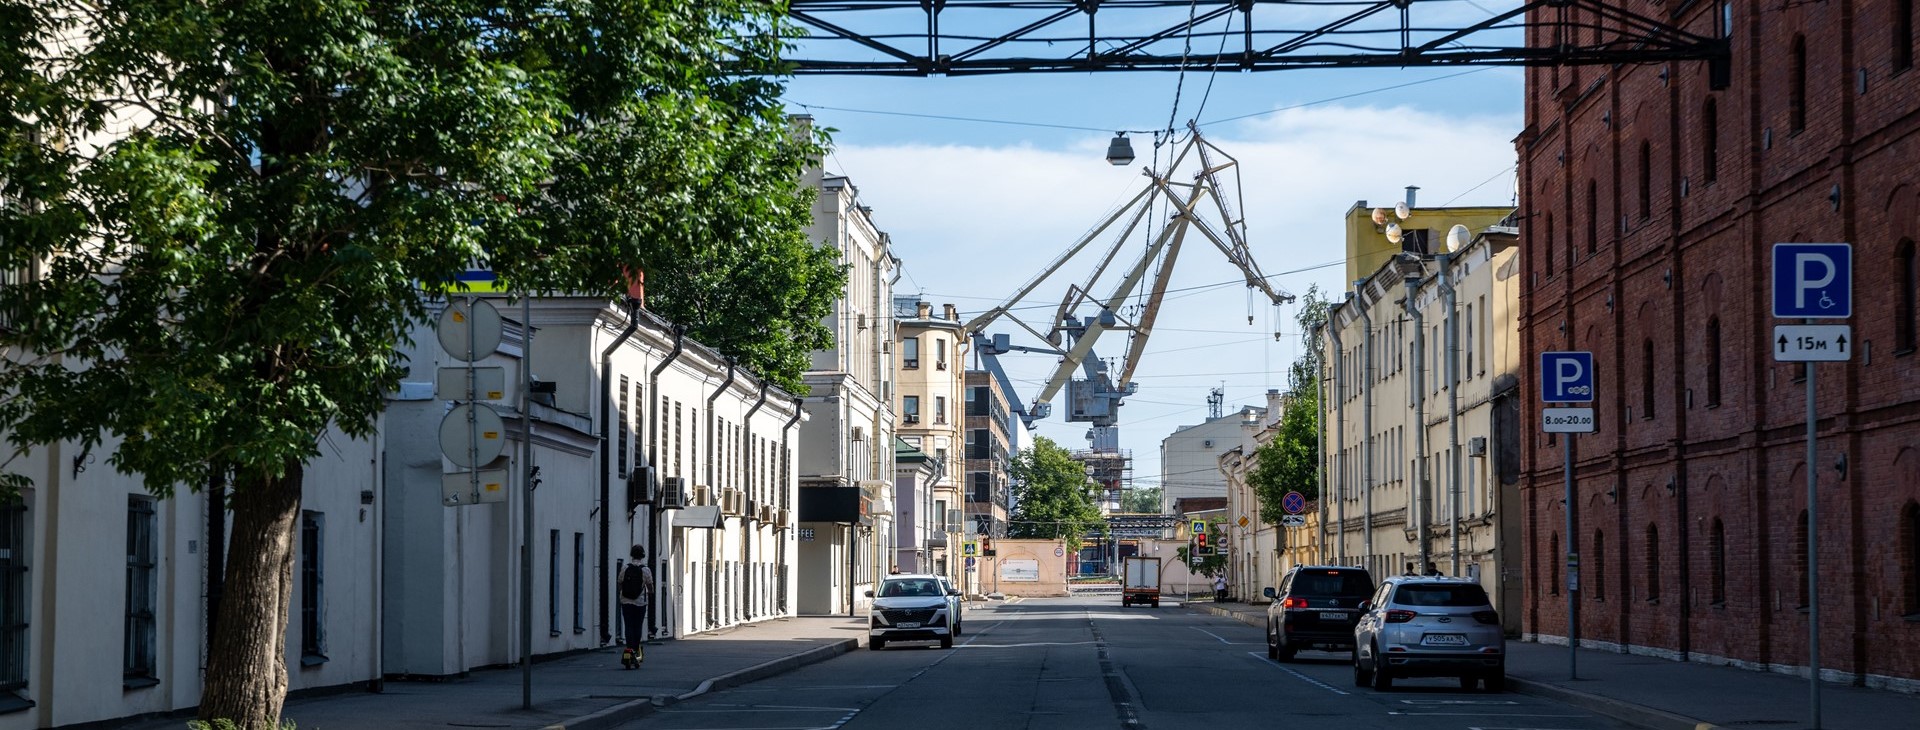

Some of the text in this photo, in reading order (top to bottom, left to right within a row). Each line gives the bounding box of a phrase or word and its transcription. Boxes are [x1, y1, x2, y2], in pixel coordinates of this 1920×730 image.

[1796, 253, 1836, 308] P
[1556, 358, 1583, 396] P
[1545, 415, 1591, 425] 8.00-20.00
